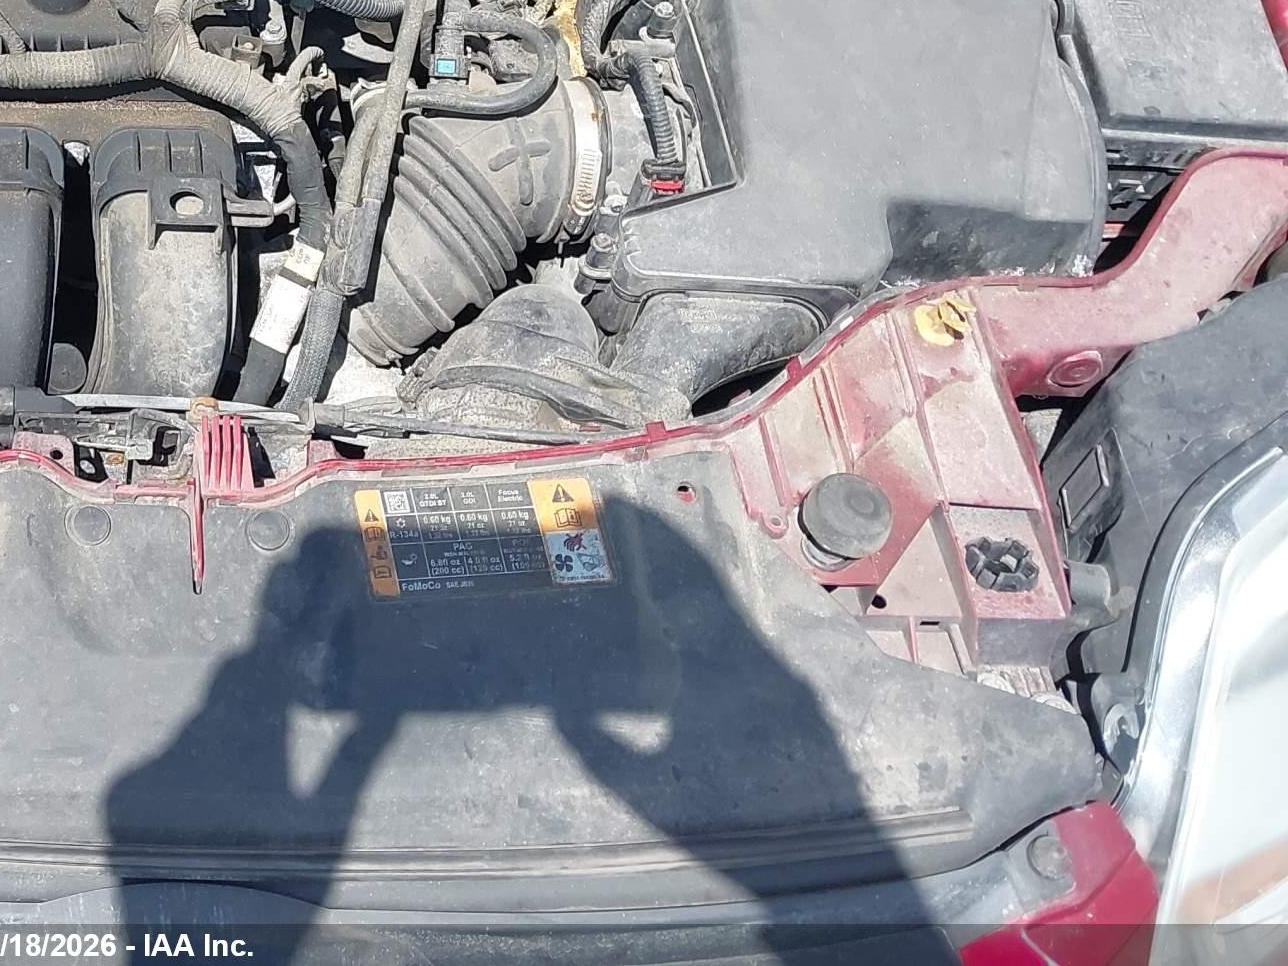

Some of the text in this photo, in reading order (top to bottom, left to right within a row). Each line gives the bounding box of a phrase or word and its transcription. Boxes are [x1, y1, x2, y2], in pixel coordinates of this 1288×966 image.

[497, 495, 523, 503] Electric
[440, 513, 451, 525] kg
[477, 512, 489, 523] kg
[518, 509, 530, 521] kg
[389, 529, 419, 539] R-134a
[452, 542, 473, 551] PAG
[451, 565, 465, 575] cc)
[402, 580, 442, 592] FoMoCo
